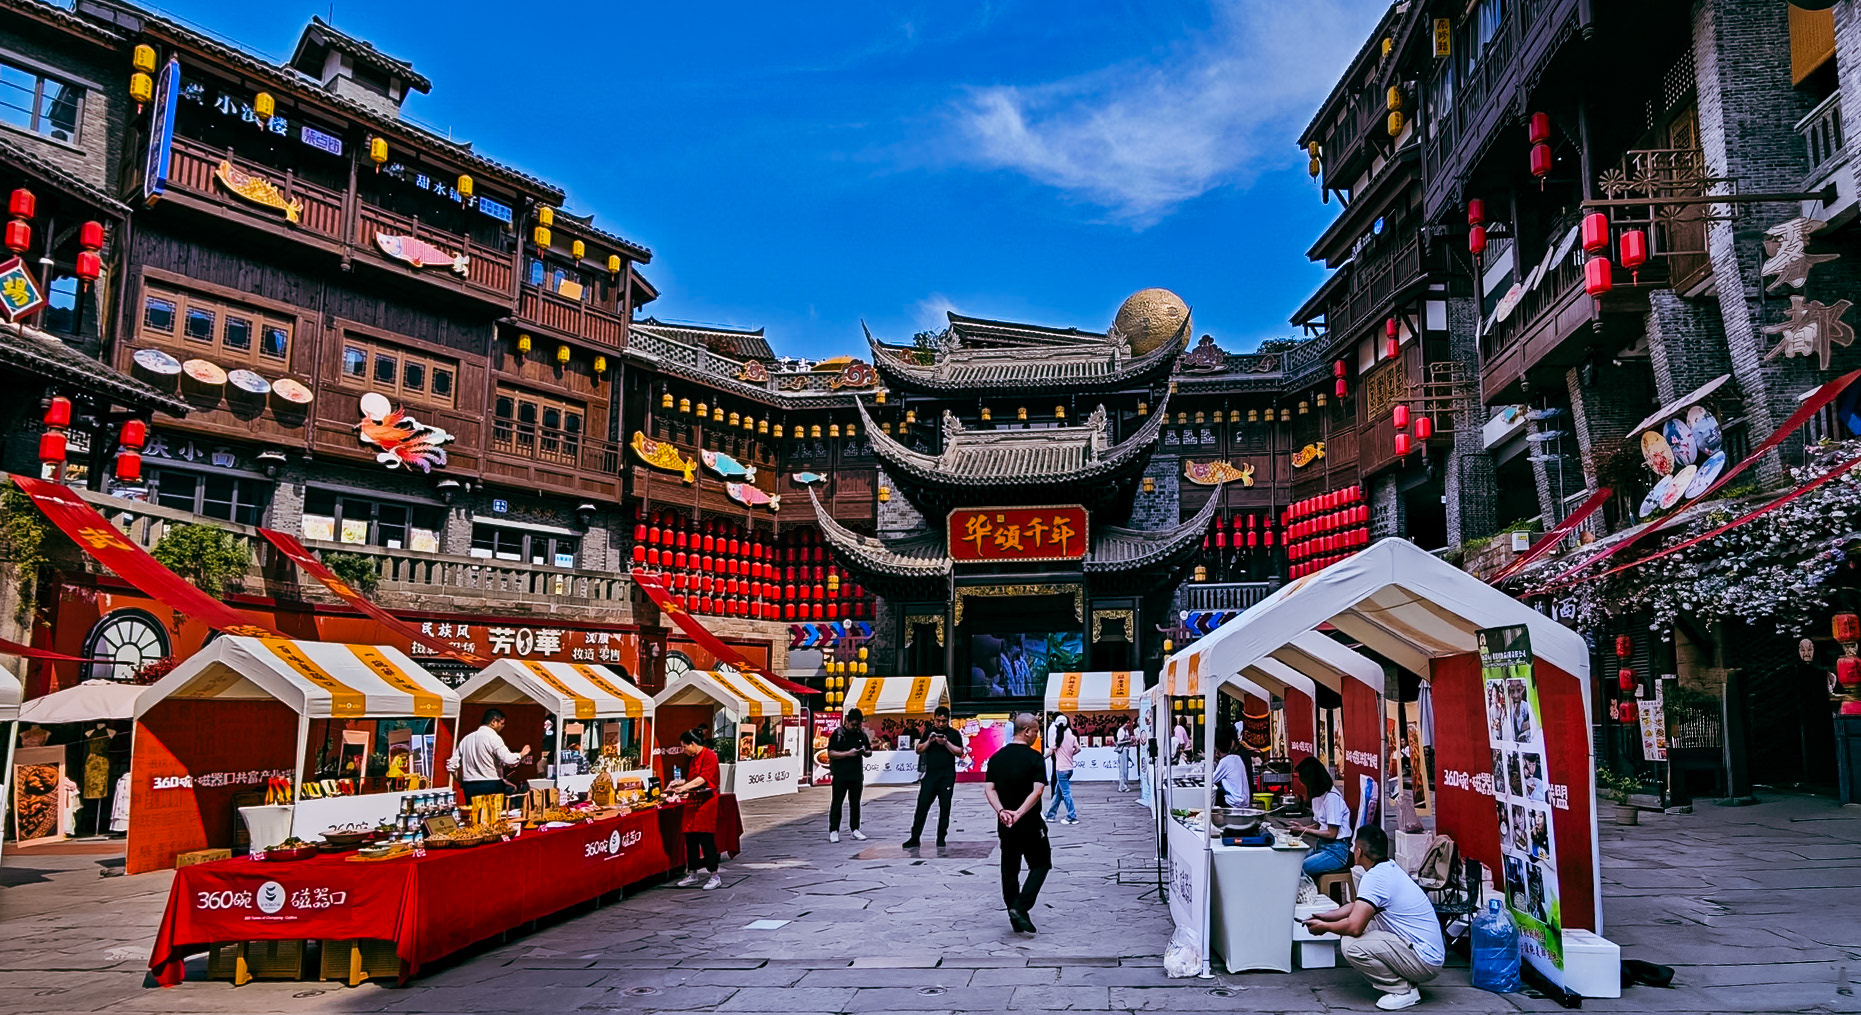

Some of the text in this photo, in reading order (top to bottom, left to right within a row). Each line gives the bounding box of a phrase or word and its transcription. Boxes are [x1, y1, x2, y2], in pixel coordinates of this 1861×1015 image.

[116, 435, 235, 468] 庆小面
[421, 621, 471, 639] 民族风
[197, 890, 252, 910] 360碗
[291, 887, 347, 909] 磁器口
